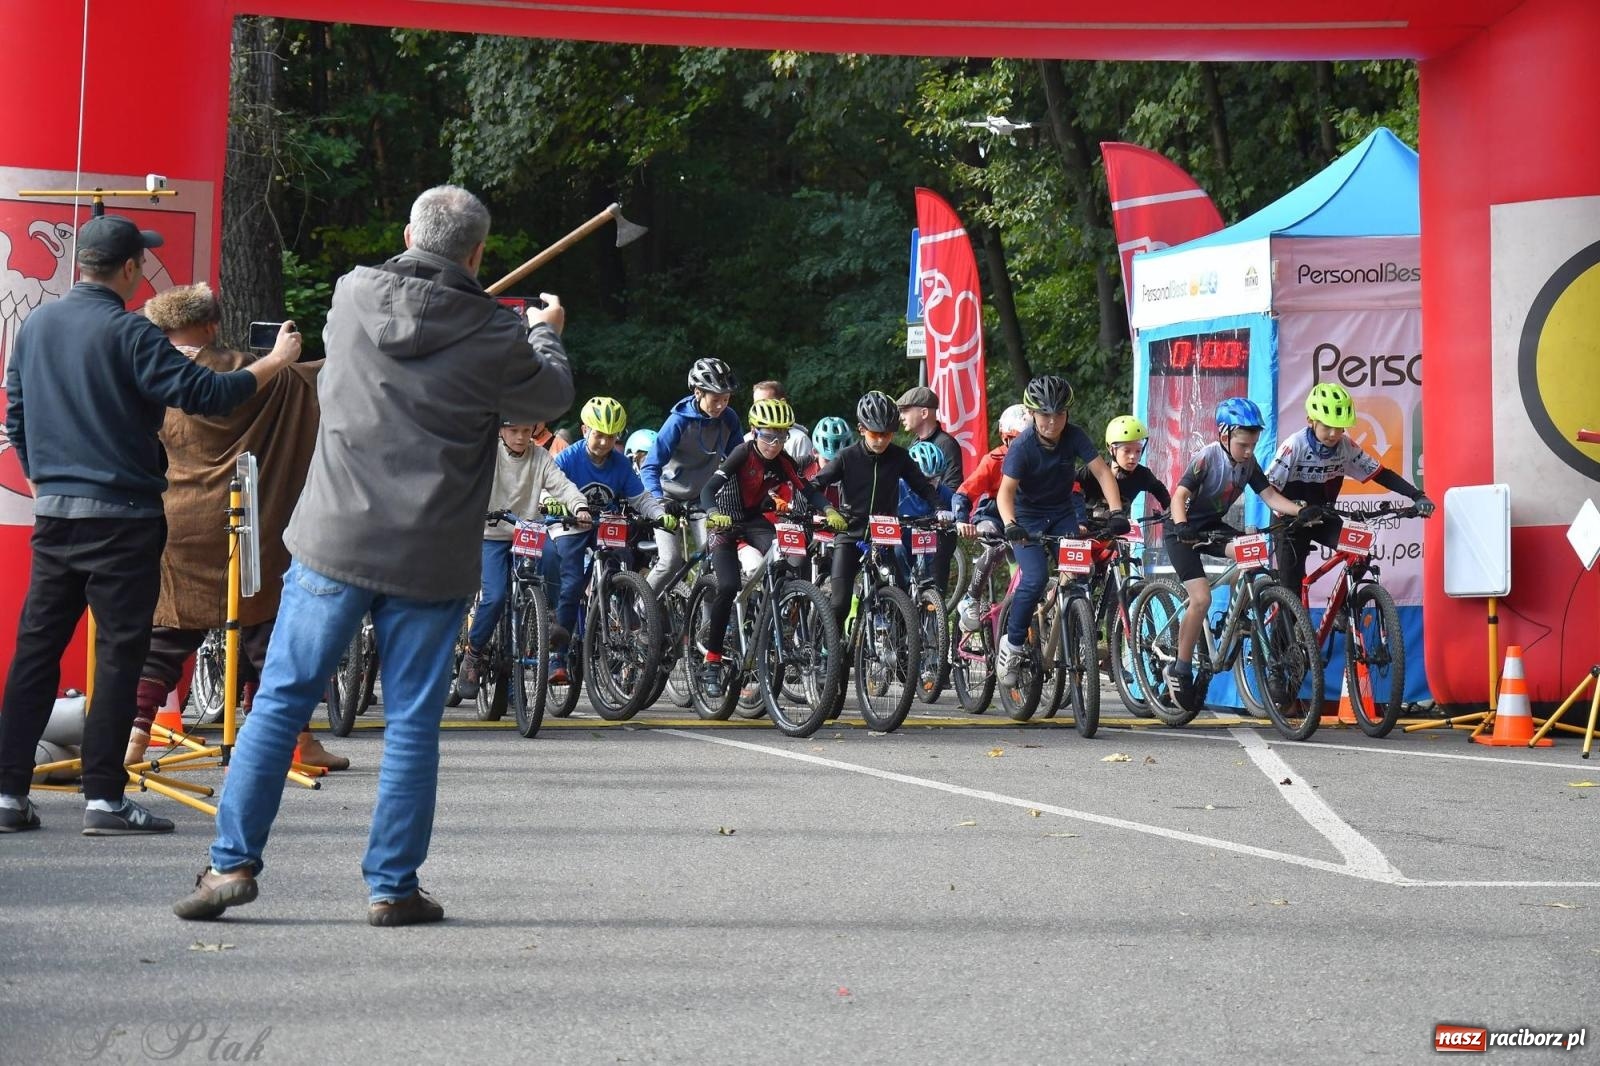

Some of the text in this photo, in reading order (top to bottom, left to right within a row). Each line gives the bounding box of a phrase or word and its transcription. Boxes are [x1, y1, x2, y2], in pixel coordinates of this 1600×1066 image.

[1297, 262, 1421, 284] PersonalBes
[1312, 342, 1422, 388] Perso
[876, 525, 895, 535] 60
[783, 533, 800, 544] 65
[1347, 532, 1365, 544] 67
[1066, 551, 1084, 562] 98
[1242, 546, 1260, 558] 59
